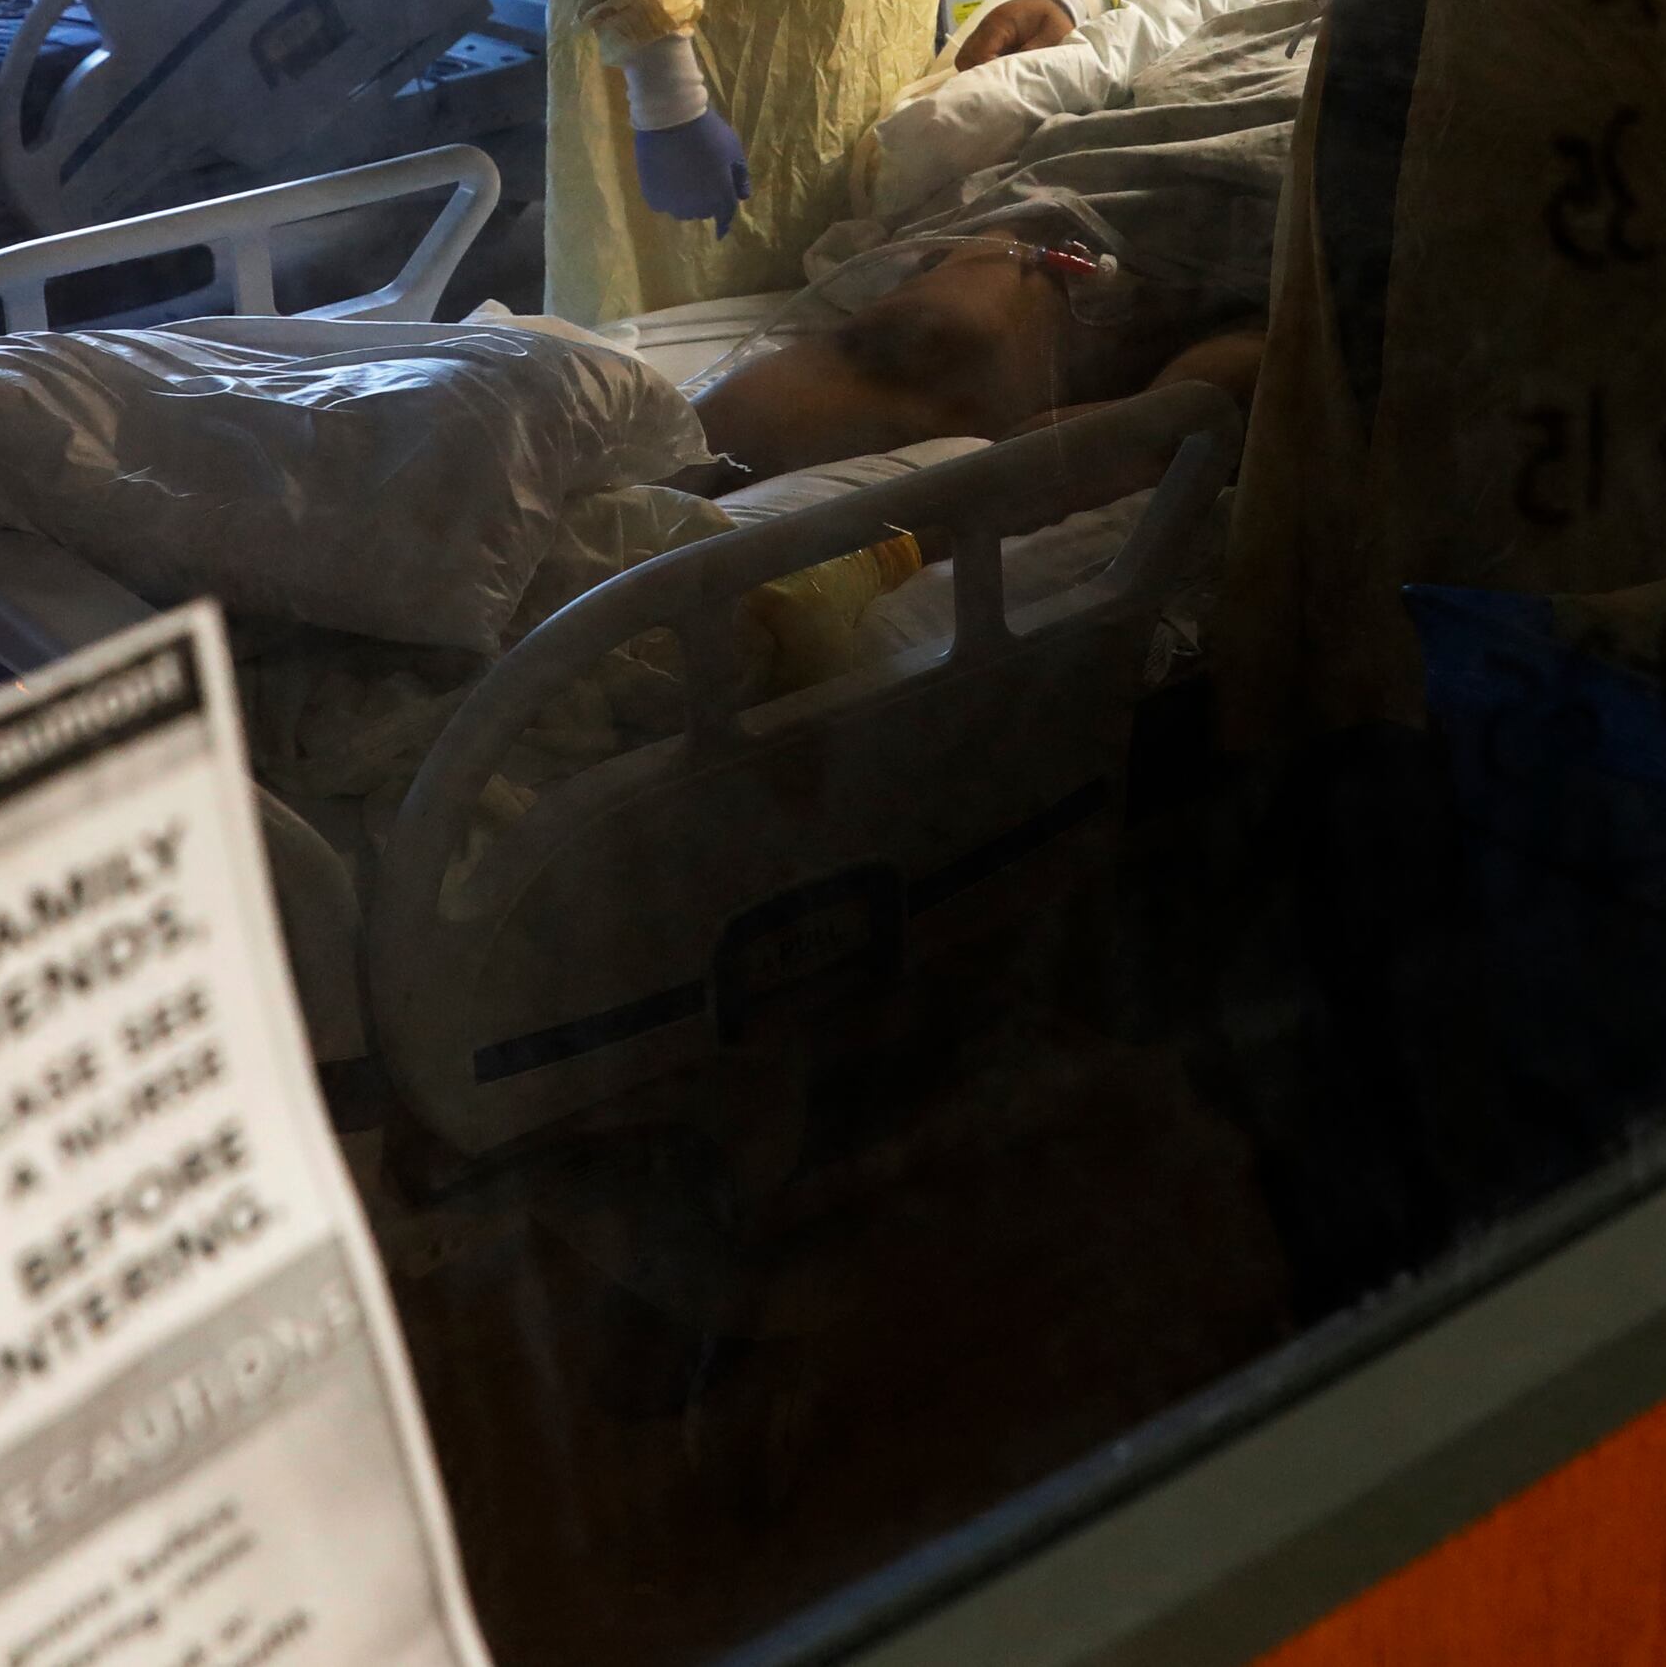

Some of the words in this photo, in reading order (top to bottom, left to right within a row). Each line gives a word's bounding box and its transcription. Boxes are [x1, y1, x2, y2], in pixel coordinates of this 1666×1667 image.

[121, 981, 214, 1059] SEE
[5, 1152, 43, 1201] A
[58, 1046, 229, 1168] NURSE
[17, 1113, 250, 1303] BEFORE
